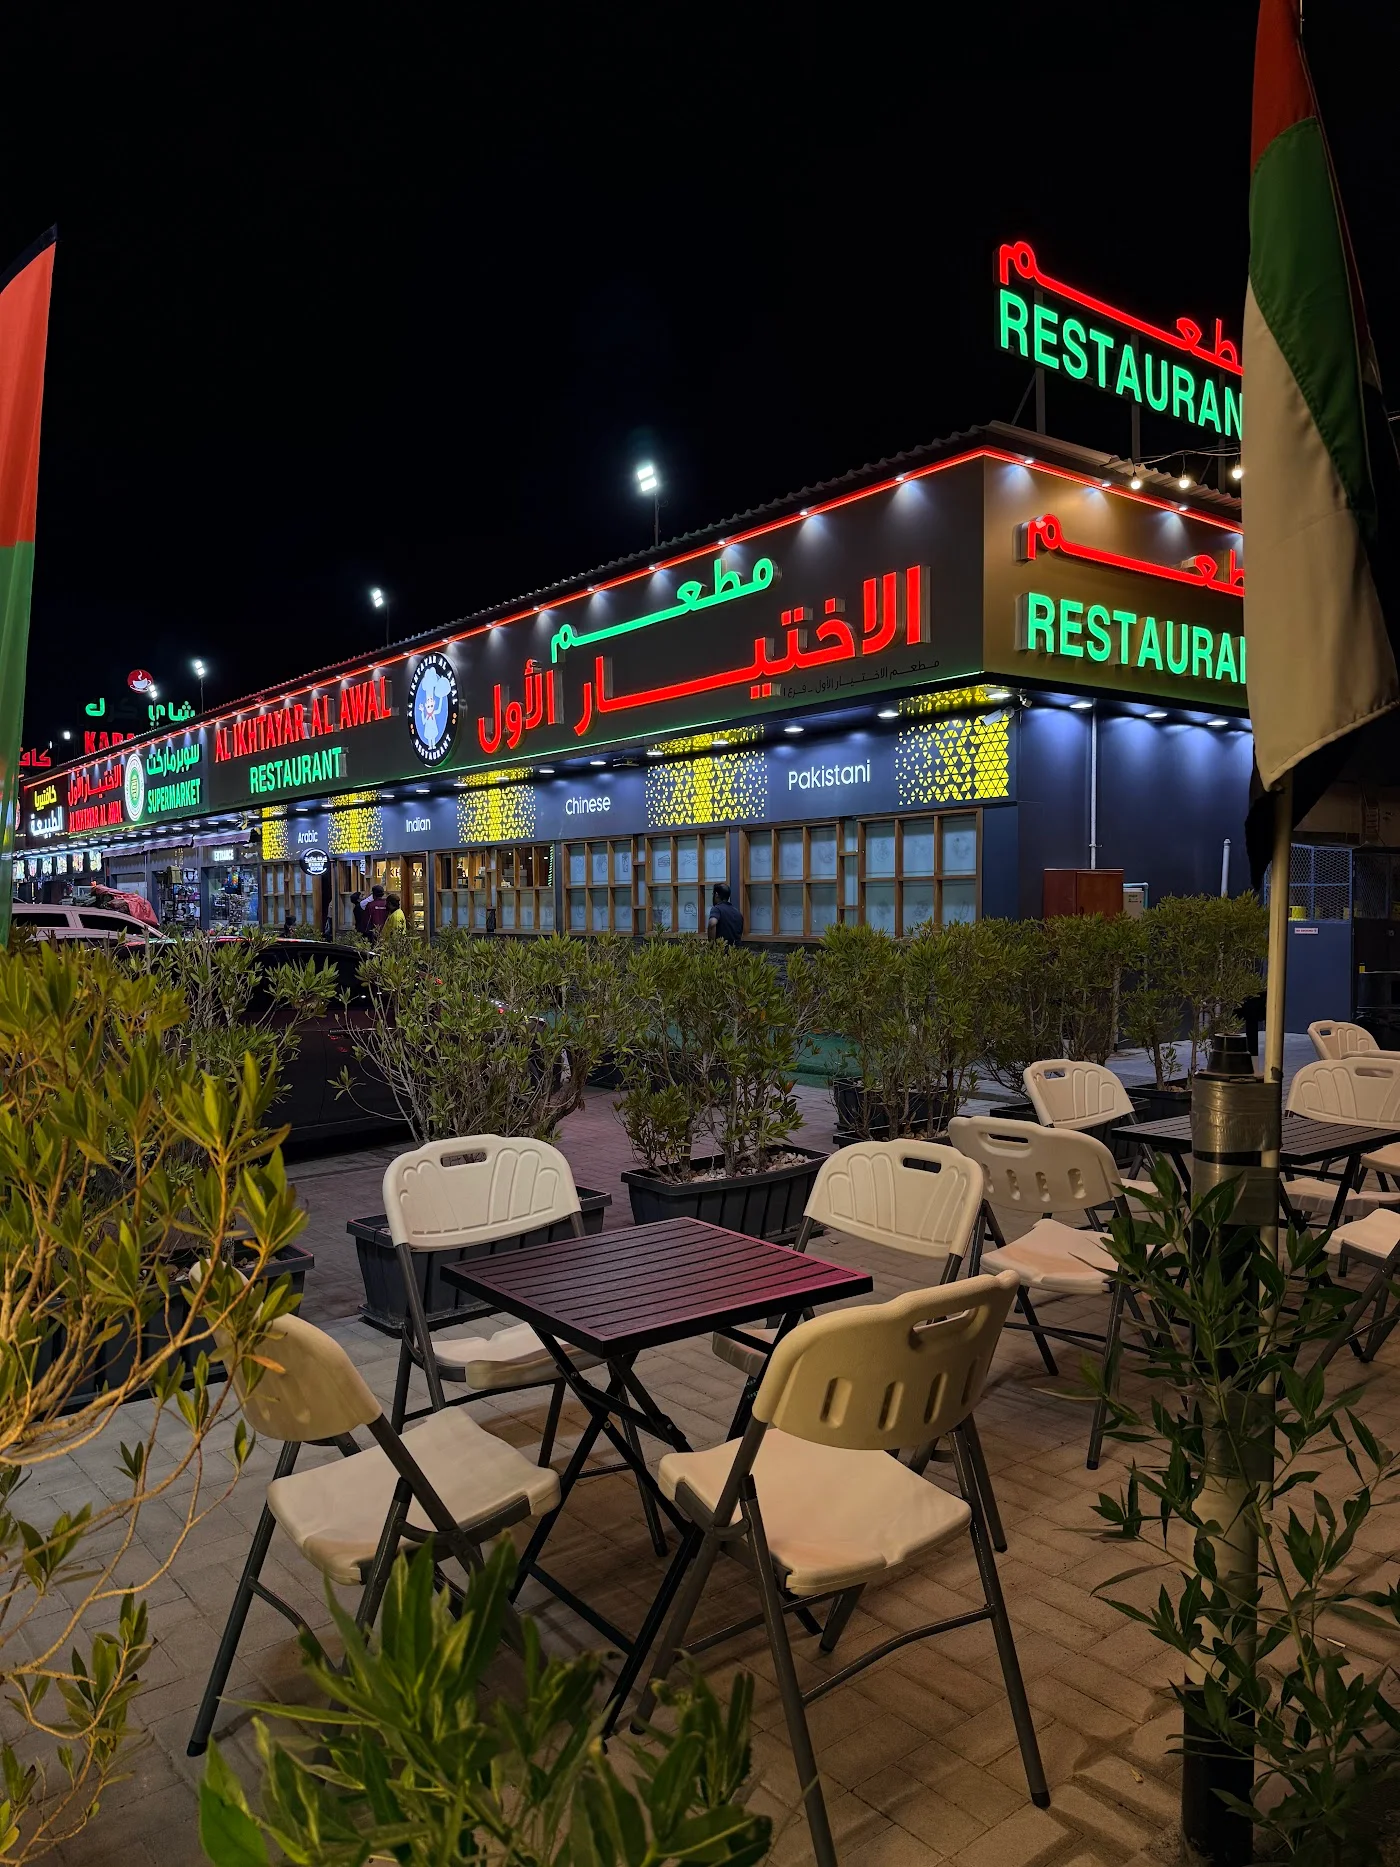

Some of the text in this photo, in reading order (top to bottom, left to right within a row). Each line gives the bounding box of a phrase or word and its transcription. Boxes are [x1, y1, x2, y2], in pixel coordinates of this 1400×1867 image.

[1000, 241, 1244, 377] طعم
[1000, 288, 1243, 441] RESTAURAN
[1027, 514, 1245, 597] طعم
[551, 557, 777, 663] مطعم
[1027, 592, 1247, 685] RESTAURA
[477, 565, 923, 754] الاختيار الأول
[889, 659, 940, 681] مطعم
[215, 675, 392, 763] AL IKHTAYAR AL AWAL
[147, 778, 200, 813] SUPERMARKET
[250, 746, 342, 794] RESTAURANT
[787, 760, 871, 791] Pakistani
[297, 830, 318, 844] Arabic
[405, 817, 431, 833] Indian
[564, 795, 611, 816] Chinese
